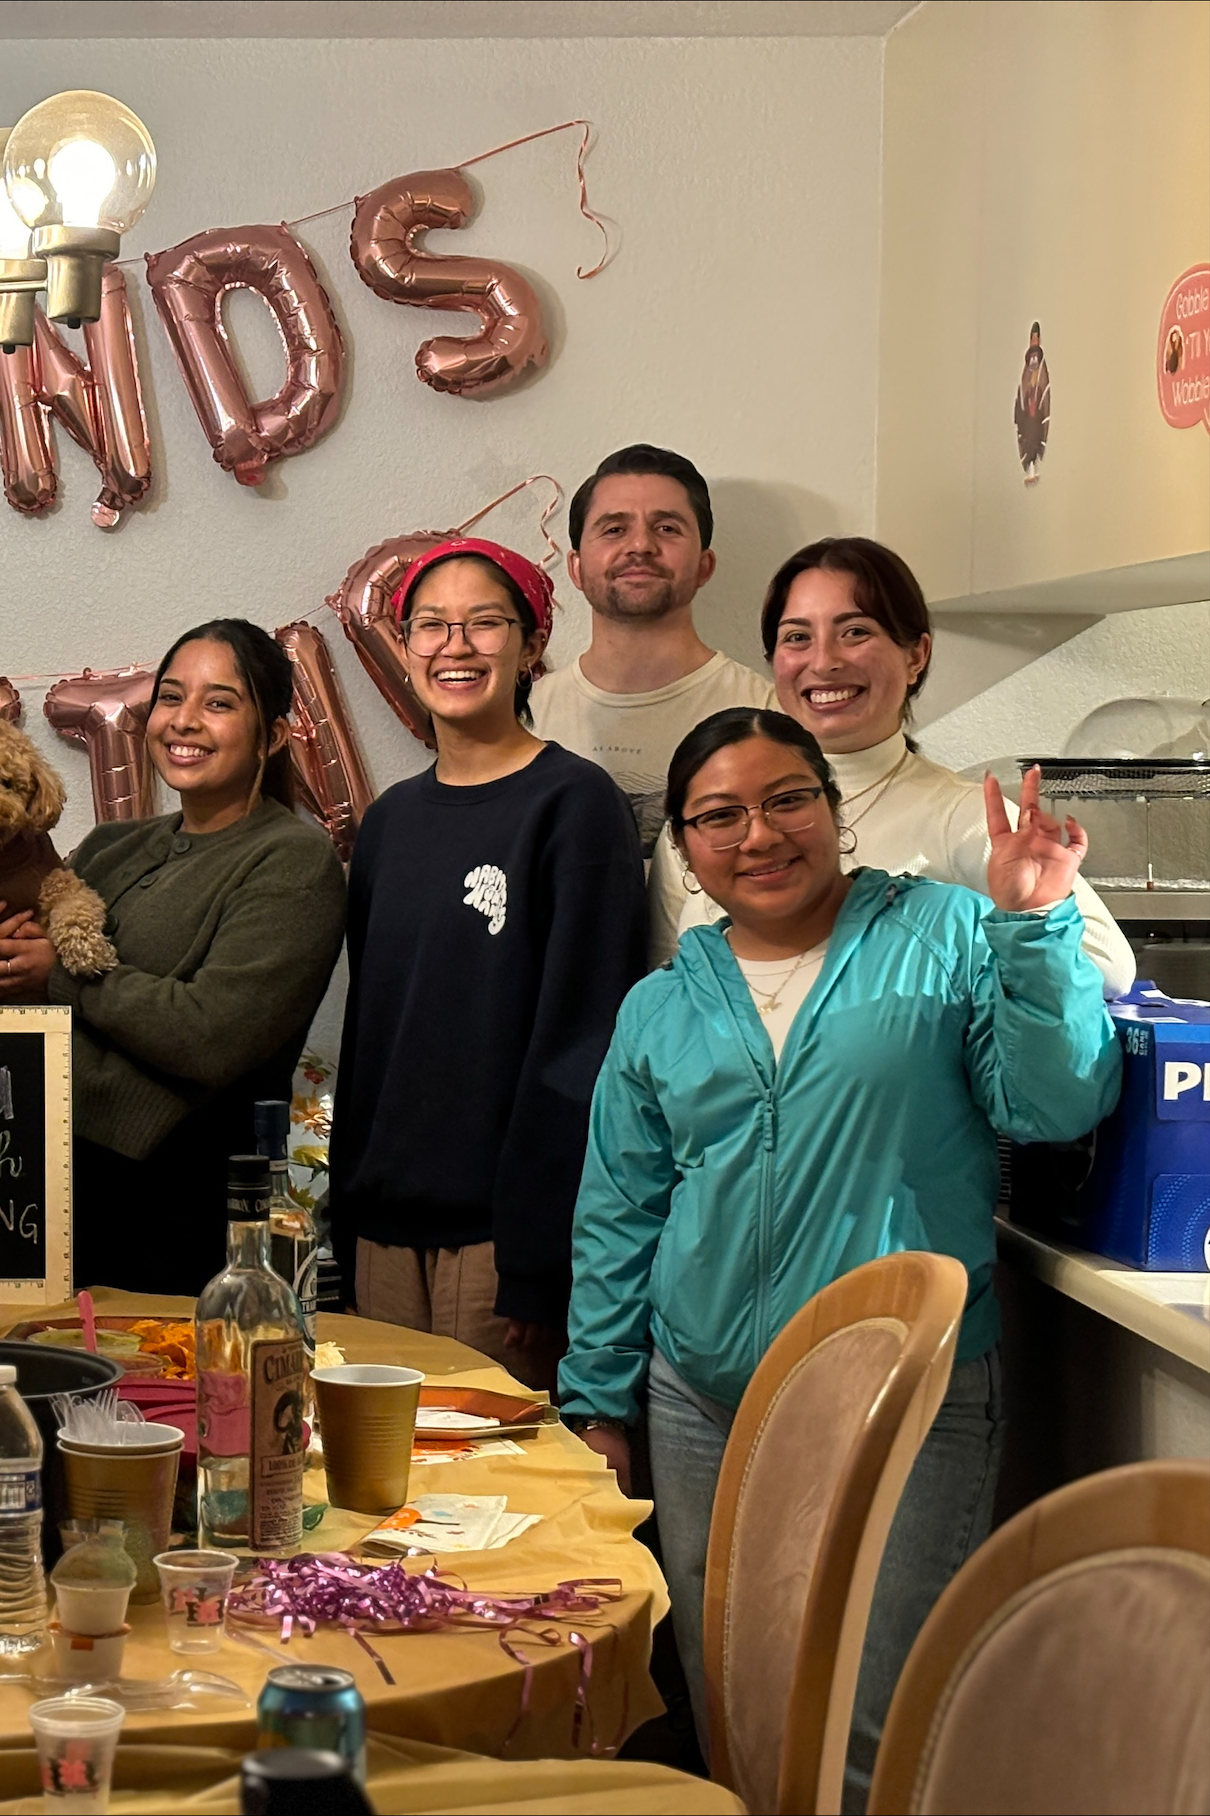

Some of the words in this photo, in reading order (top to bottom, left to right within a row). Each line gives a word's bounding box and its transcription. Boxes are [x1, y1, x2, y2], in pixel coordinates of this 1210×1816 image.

[1175, 285, 1209, 320] Gobble
[1171, 374, 1210, 407] Wobble
[1126, 1027, 1139, 1055] 36
